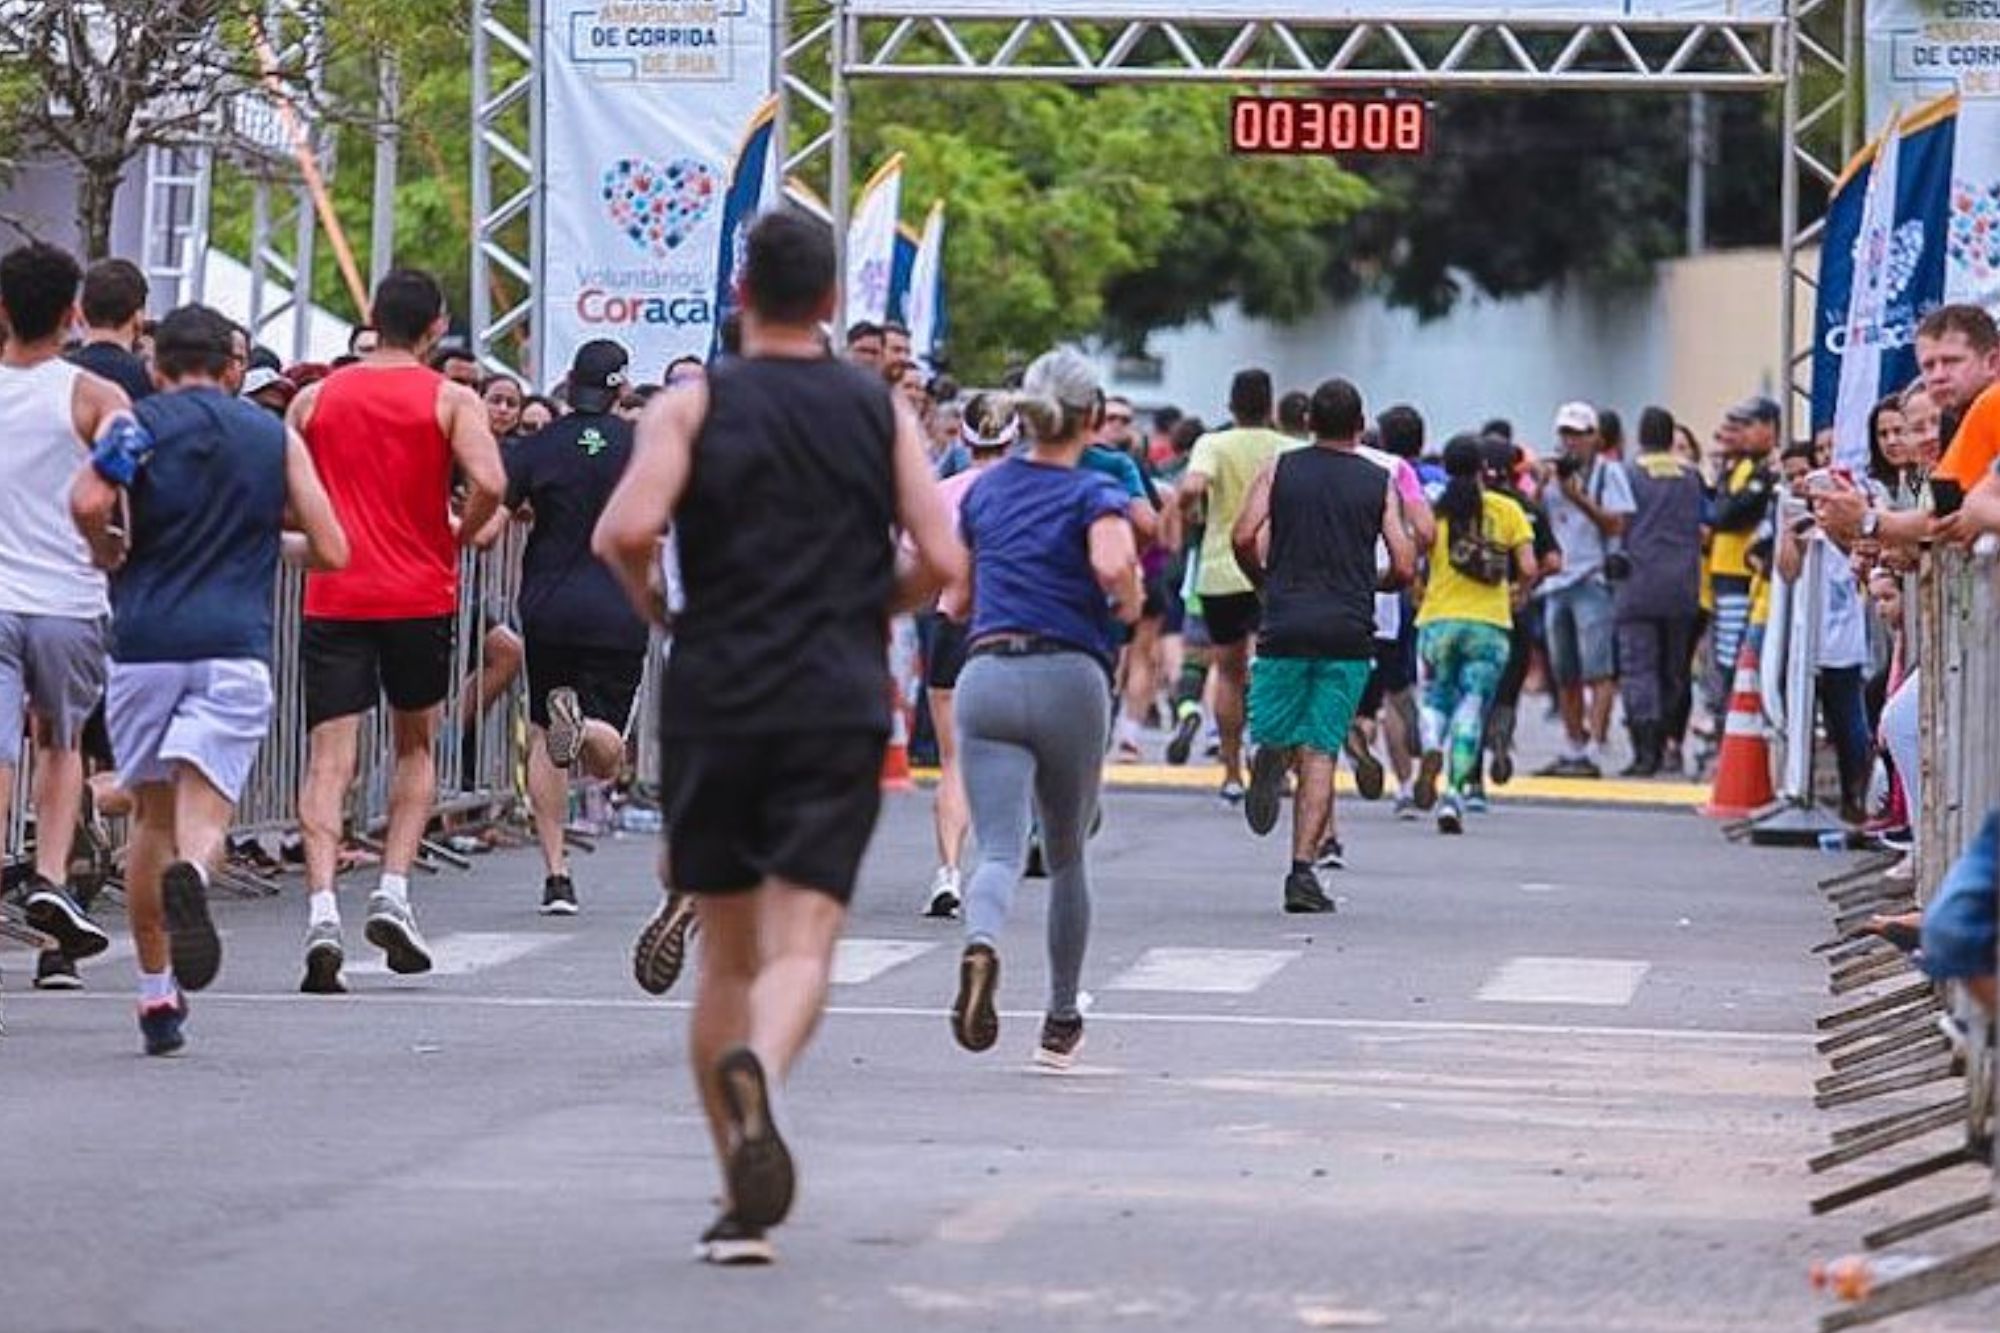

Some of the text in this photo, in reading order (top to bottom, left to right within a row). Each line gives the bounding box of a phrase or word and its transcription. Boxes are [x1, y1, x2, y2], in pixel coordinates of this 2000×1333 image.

[591, 27, 717, 47] DE CORRIDA
[1912, 45, 1940, 66] DE
[1235, 101, 1421, 150] 003008
[577, 288, 710, 329] Coraçã
